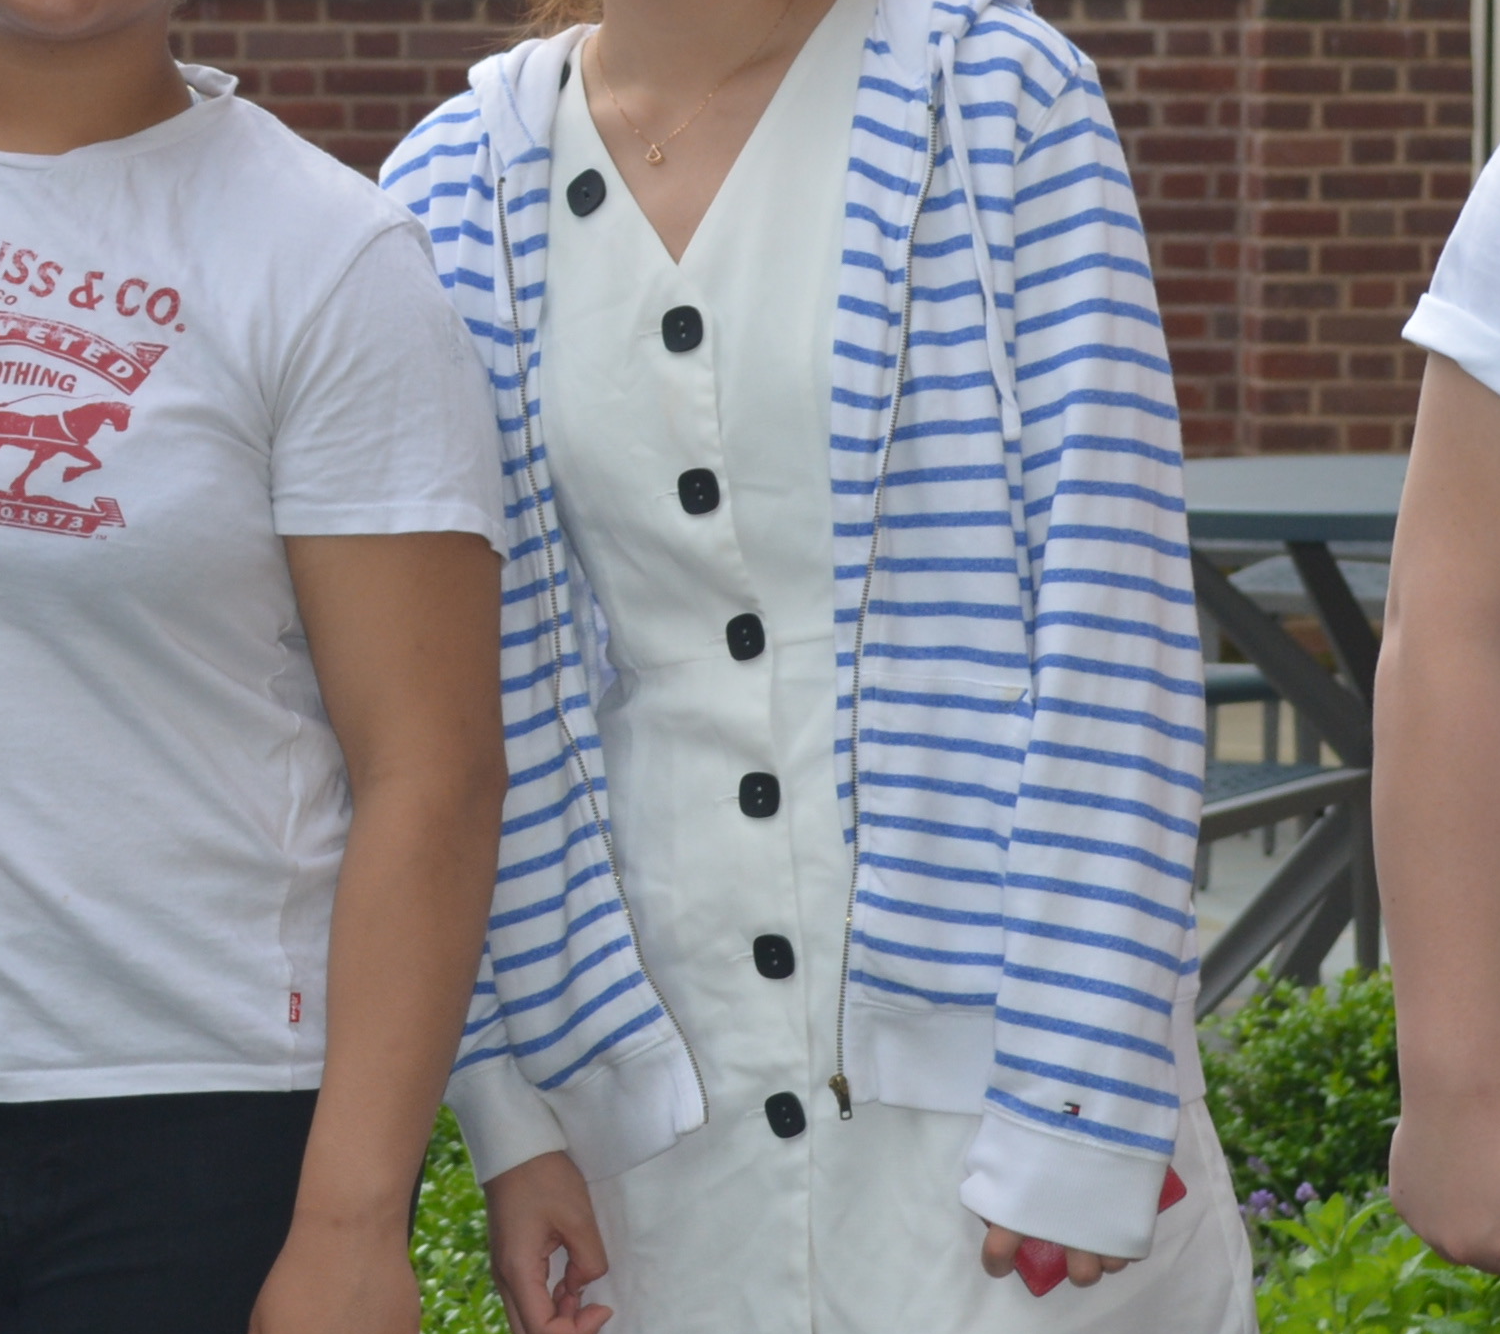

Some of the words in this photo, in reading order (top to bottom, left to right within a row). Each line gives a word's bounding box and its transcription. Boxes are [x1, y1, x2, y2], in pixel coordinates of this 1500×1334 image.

[68, 270, 105, 311] &
[115, 277, 187, 334] CO.
[21, 508, 85, 530] 1873
